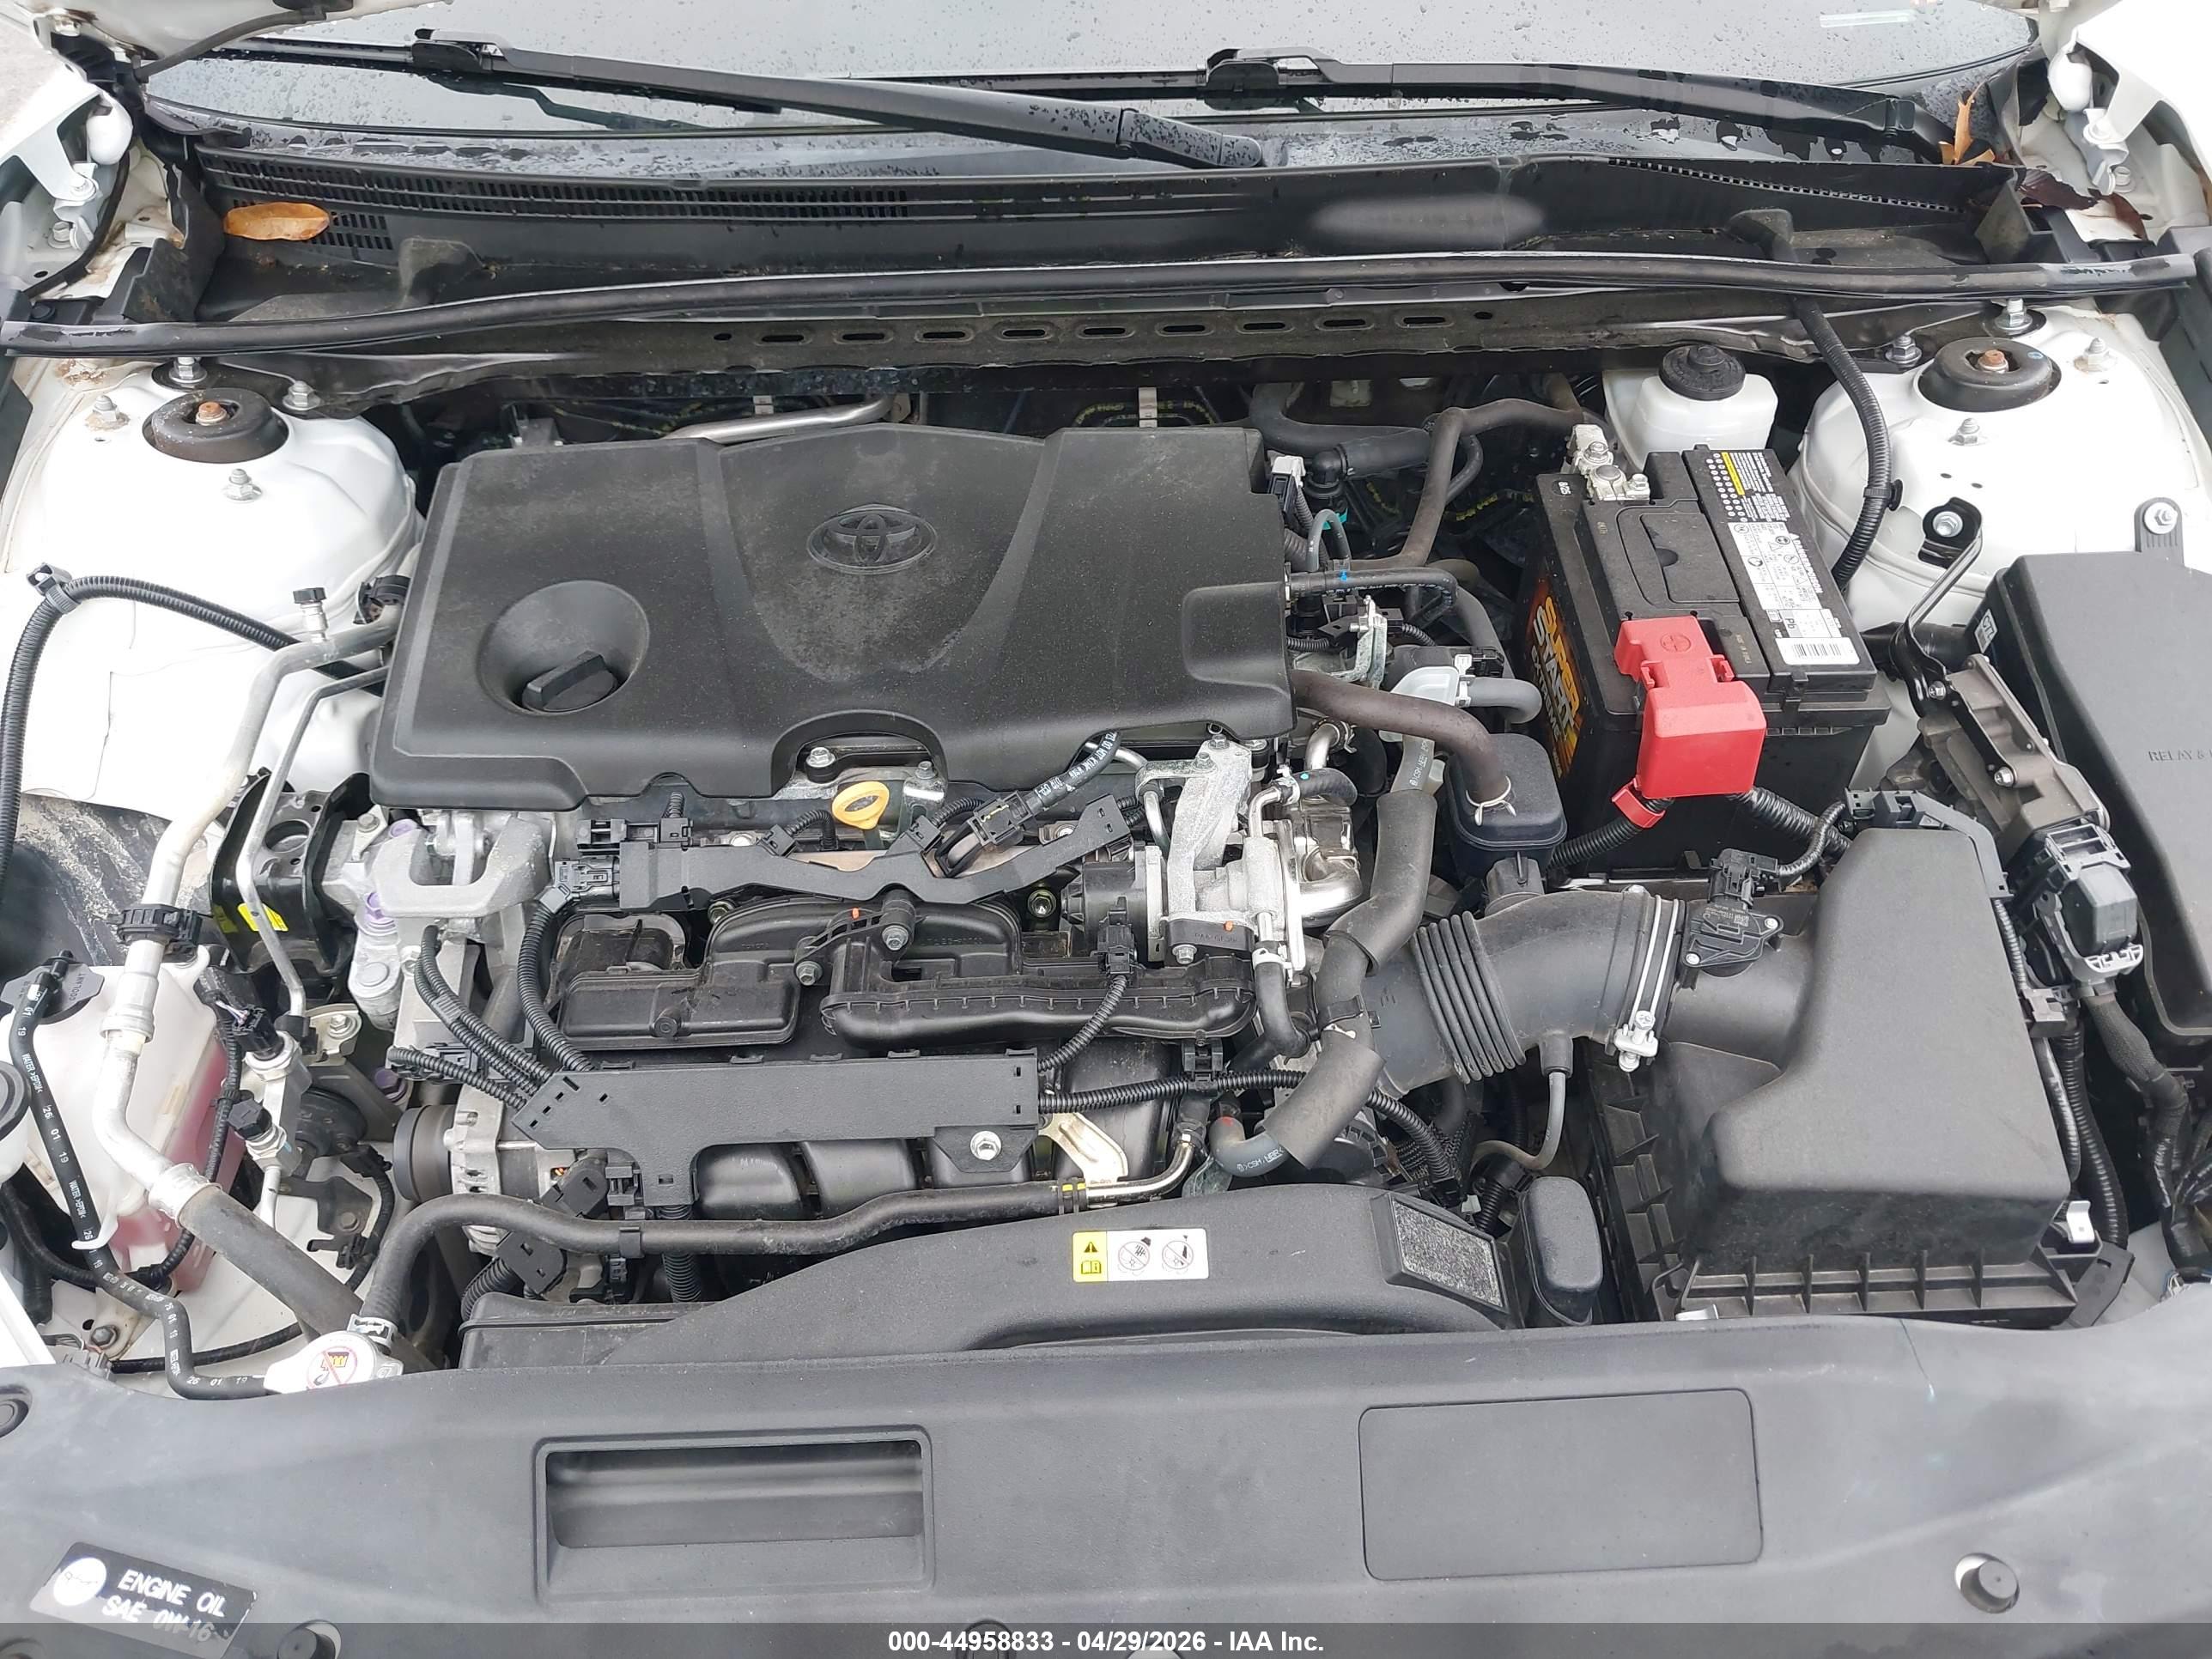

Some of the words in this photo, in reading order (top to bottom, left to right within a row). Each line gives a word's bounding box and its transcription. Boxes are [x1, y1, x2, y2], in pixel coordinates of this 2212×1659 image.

[1785, 617, 1797, 629] Pb
[1534, 605, 1575, 730] START
[1545, 596, 1580, 719] SUPER
[2148, 750, 2192, 762] RELAY
[17, 1026, 27, 1036] 19
[21, 1053, 35, 1073] WATER
[51, 1128, 61, 1140] 01
[58, 1151, 69, 1164] 19
[69, 1180, 82, 1199] WATER
[210, 1377, 222, 1386] 01
[117, 1569, 191, 1606] ENGINE
[196, 1592, 227, 1617] OIL
[101, 1595, 148, 1622] SAE
[152, 1609, 216, 1642] 0W-16
